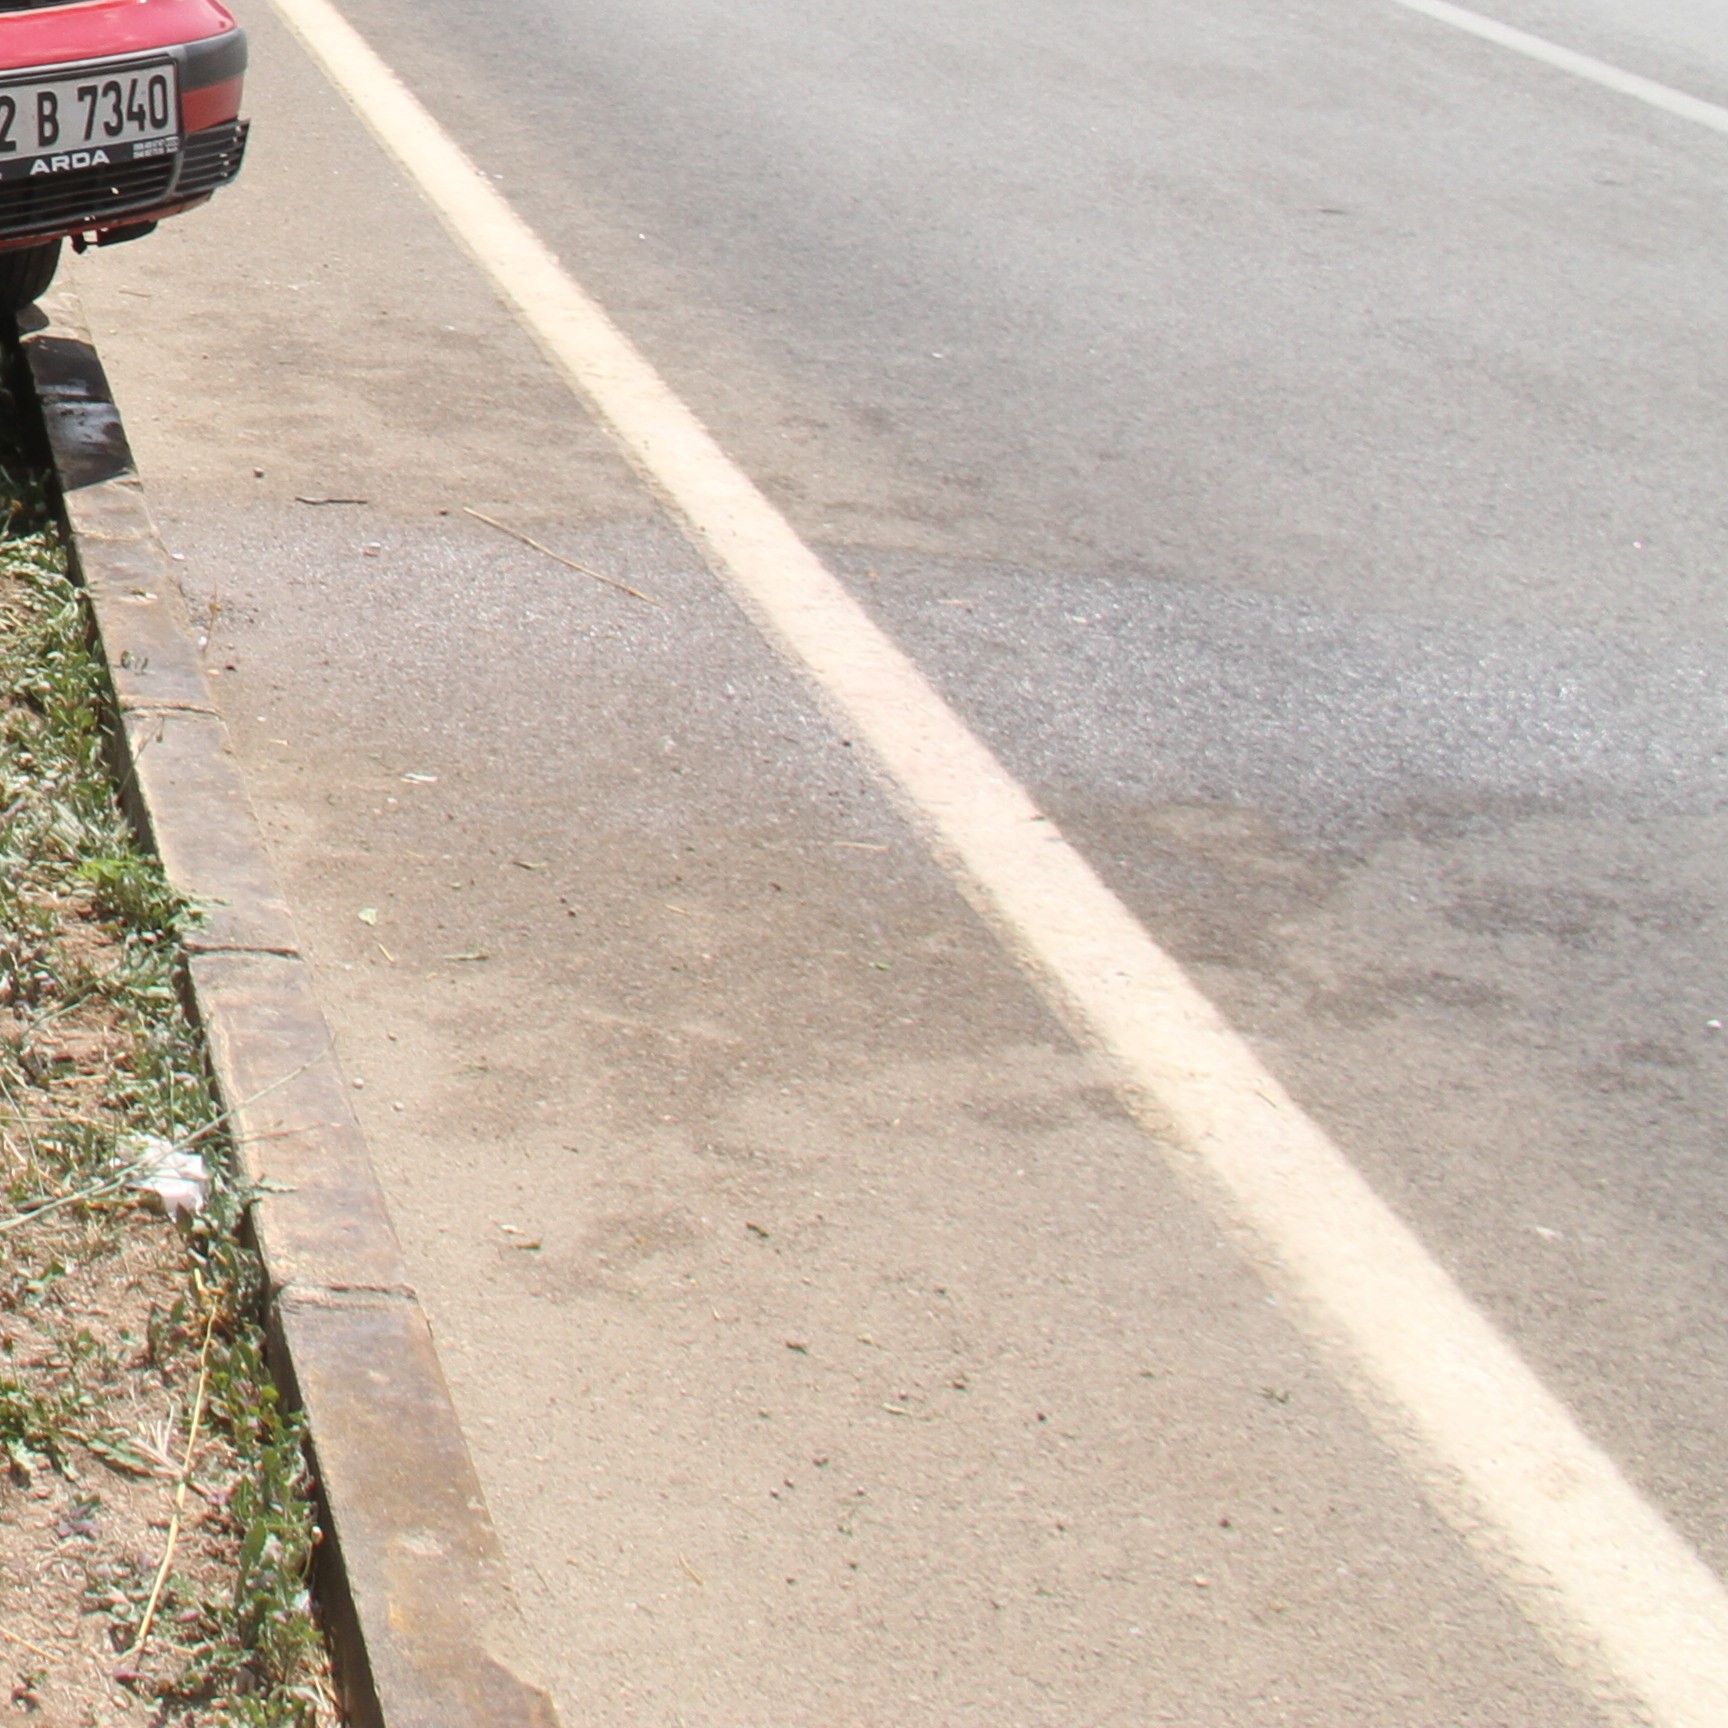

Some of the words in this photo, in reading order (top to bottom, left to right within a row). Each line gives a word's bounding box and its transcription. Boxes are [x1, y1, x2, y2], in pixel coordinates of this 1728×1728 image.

[37, 90, 60, 148] B
[76, 74, 169, 142] 7340
[29, 149, 111, 176] ARDA
